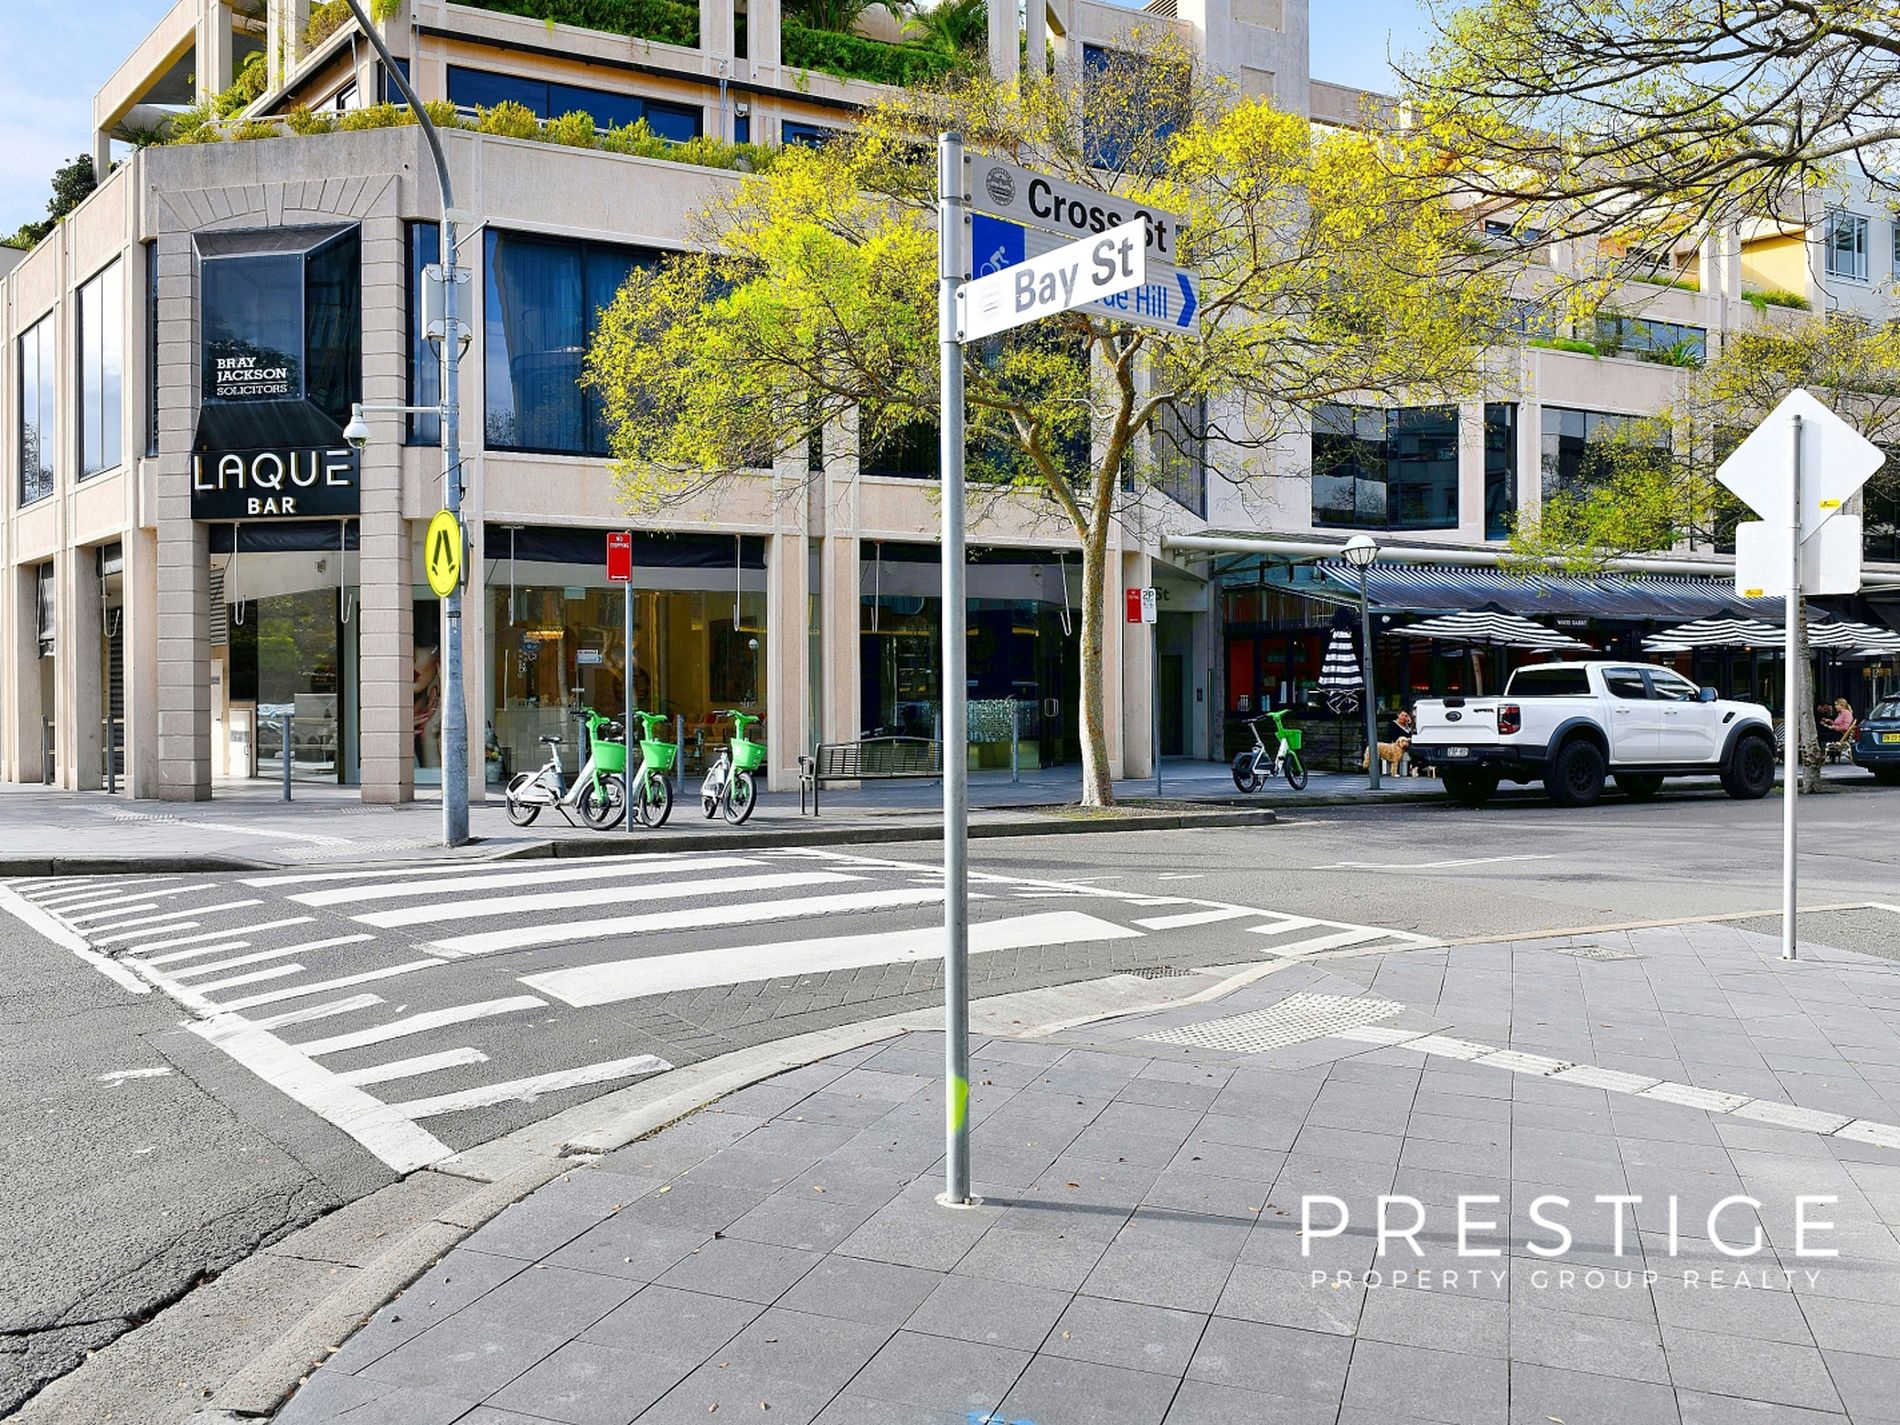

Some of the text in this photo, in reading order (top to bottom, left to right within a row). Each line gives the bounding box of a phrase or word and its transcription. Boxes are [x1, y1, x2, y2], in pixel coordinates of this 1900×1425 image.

[1028, 178, 1122, 234] Cross
[1014, 262, 1079, 313] Bay
[1092, 237, 1134, 286] St
[1136, 285, 1167, 319] Hill
[215, 356, 257, 369] BRAY
[216, 367, 288, 383] JACKSON
[216, 384, 288, 396] SOLICITORS
[194, 450, 352, 490] LAQUE
[248, 497, 296, 514] BAR
